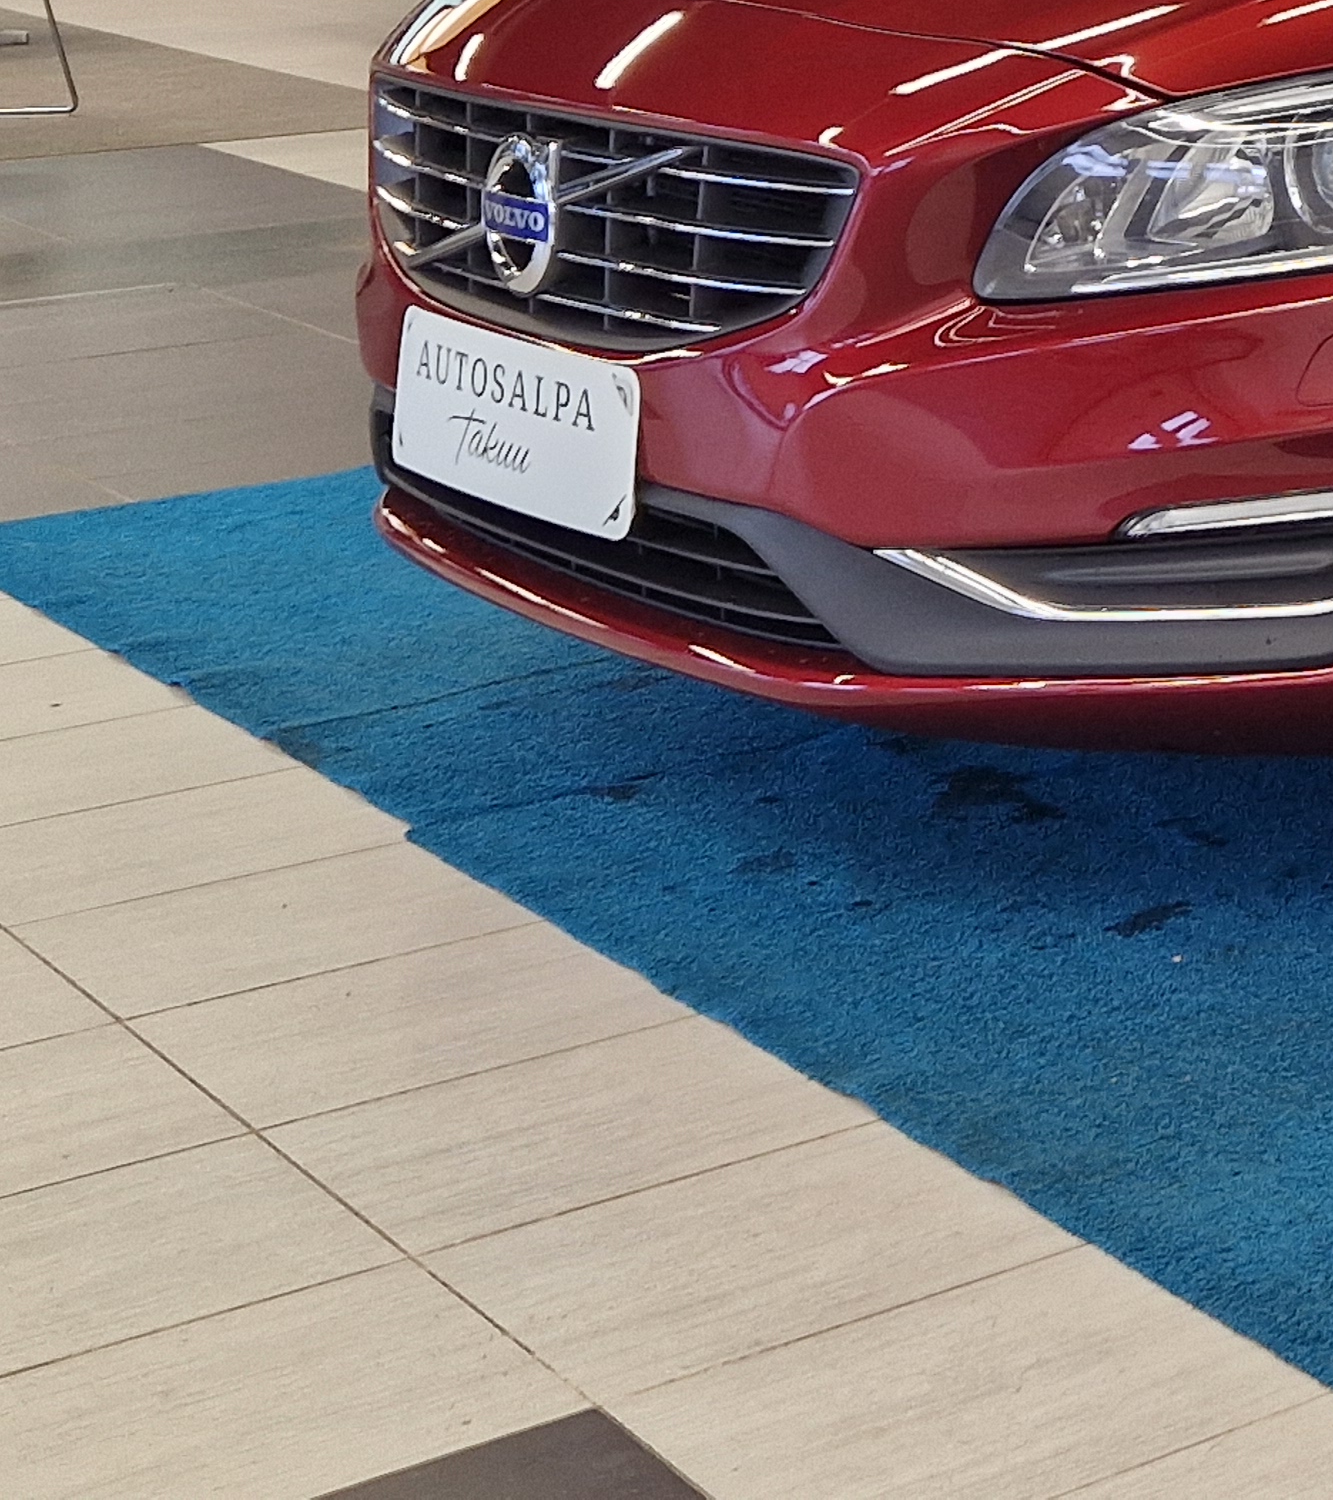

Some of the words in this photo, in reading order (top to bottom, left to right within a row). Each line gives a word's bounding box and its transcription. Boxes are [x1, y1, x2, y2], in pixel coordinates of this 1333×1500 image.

[484, 201, 546, 233] VOLVO
[415, 340, 596, 432] AUTOSALPA
[448, 407, 532, 474] Takuu
